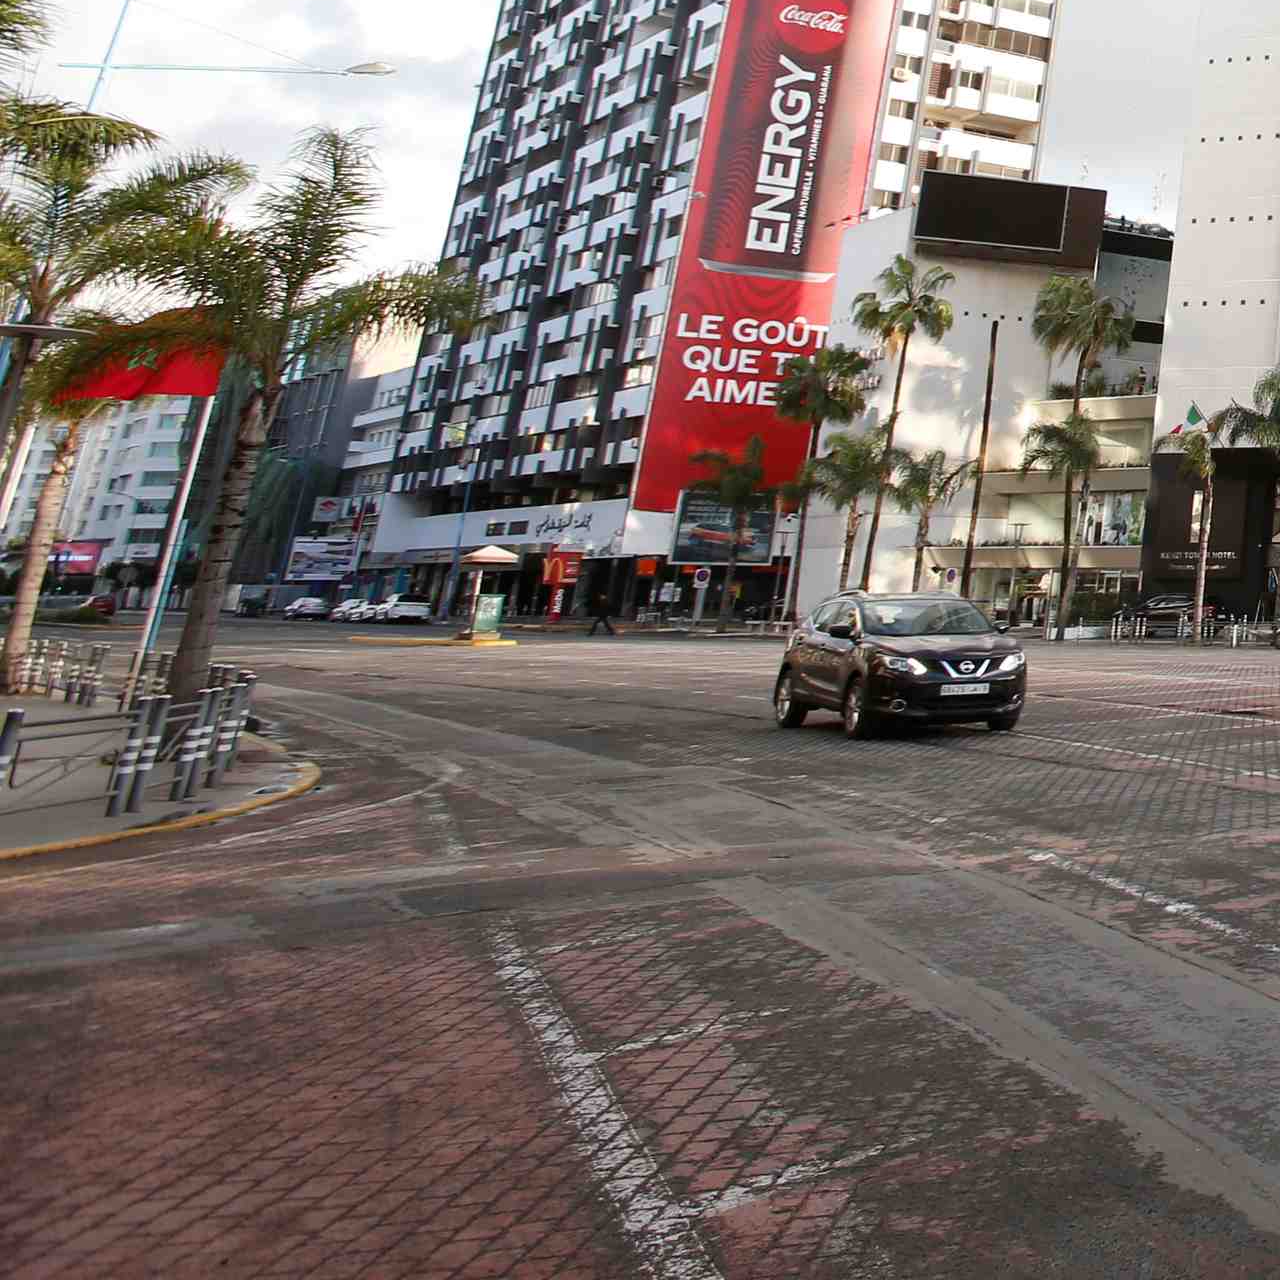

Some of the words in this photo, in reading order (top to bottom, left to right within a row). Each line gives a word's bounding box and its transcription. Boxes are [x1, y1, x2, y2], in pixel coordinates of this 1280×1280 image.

[745, 54, 817, 253] ENERGY
[676, 313, 723, 340] LE
[732, 316, 830, 348] GOÛT
[683, 345, 762, 373] QUE
